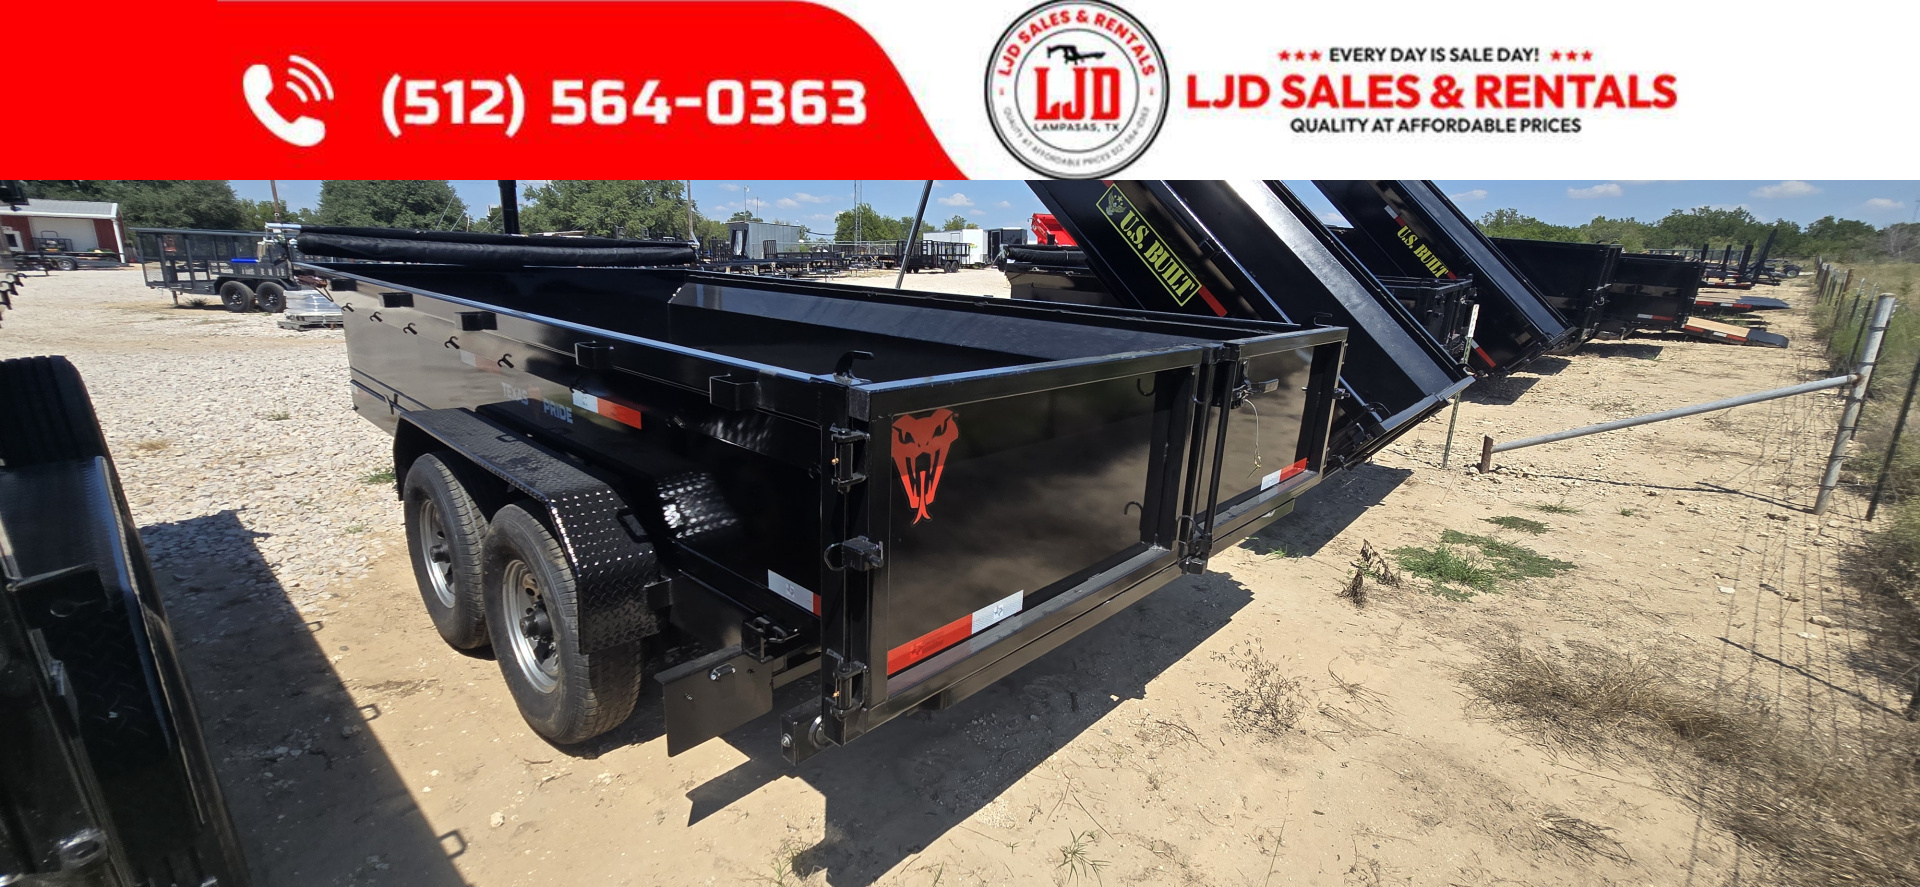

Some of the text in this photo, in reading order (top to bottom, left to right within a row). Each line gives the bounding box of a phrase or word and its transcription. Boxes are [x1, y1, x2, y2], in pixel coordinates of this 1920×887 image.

[1120, 209, 1195, 297] U.S. BUILT
[1397, 225, 1449, 278] U.S. BUILT
[501, 382, 574, 425] TEXAS PRIDE
